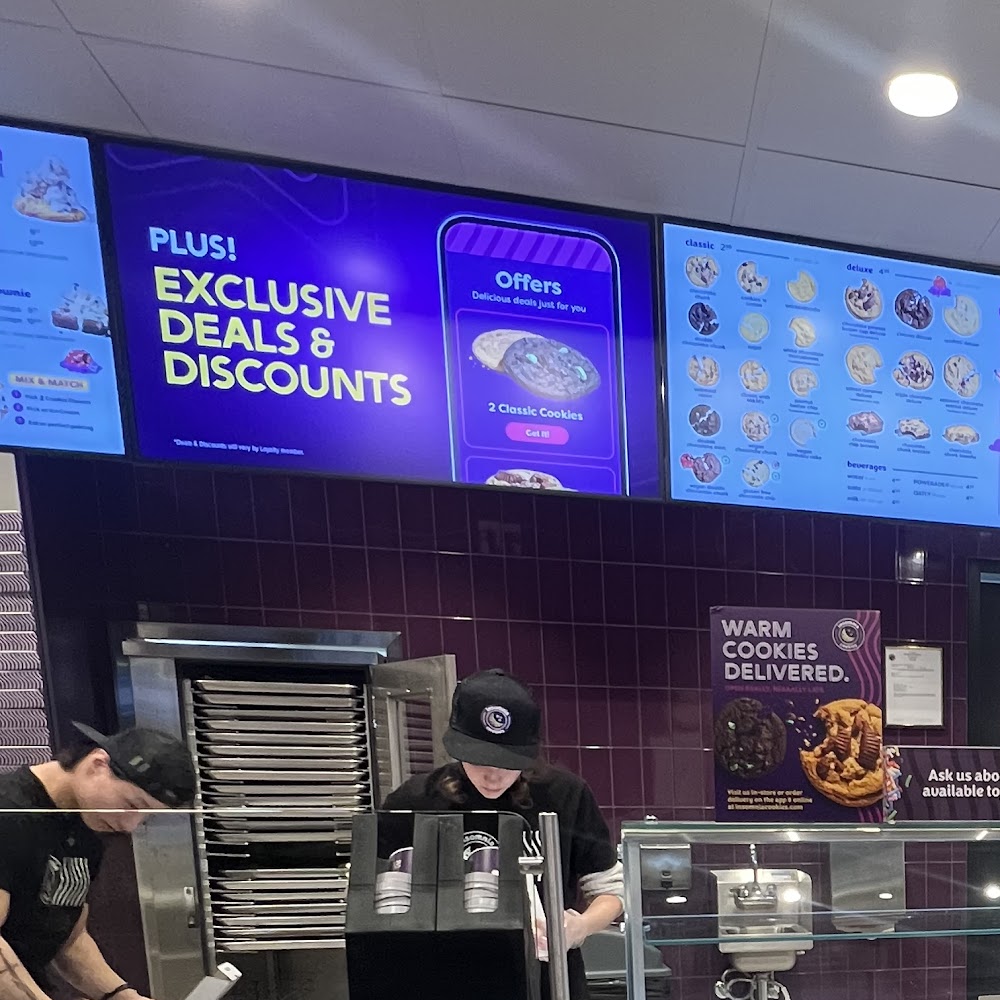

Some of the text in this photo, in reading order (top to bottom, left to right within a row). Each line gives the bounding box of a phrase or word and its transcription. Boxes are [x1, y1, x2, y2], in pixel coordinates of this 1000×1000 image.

[149, 227, 237, 261] PLUS!
[685, 239, 715, 250] classic
[846, 263, 873, 274] deluxe
[495, 271, 562, 295] Offers
[154, 266, 391, 325] EXCLUSIVE
[472, 291, 586, 314] Delicious deals just for you
[159, 308, 335, 358] DEALS &
[15, 376, 34, 384] MIX
[48, 379, 84, 388] MATCH
[164, 350, 411, 406] DISCOUNTS
[488, 402, 583, 421] 2 Classic Cookies
[525, 429, 540, 438] Get
[847, 461, 887, 473] beverages
[721, 619, 792, 638] WARM
[722, 641, 819, 661] COOKIES
[724, 662, 850, 683] DELIVERED.
[928, 768, 954, 782] Ask
[956, 771, 973, 782] us
[922, 784, 984, 798] available
